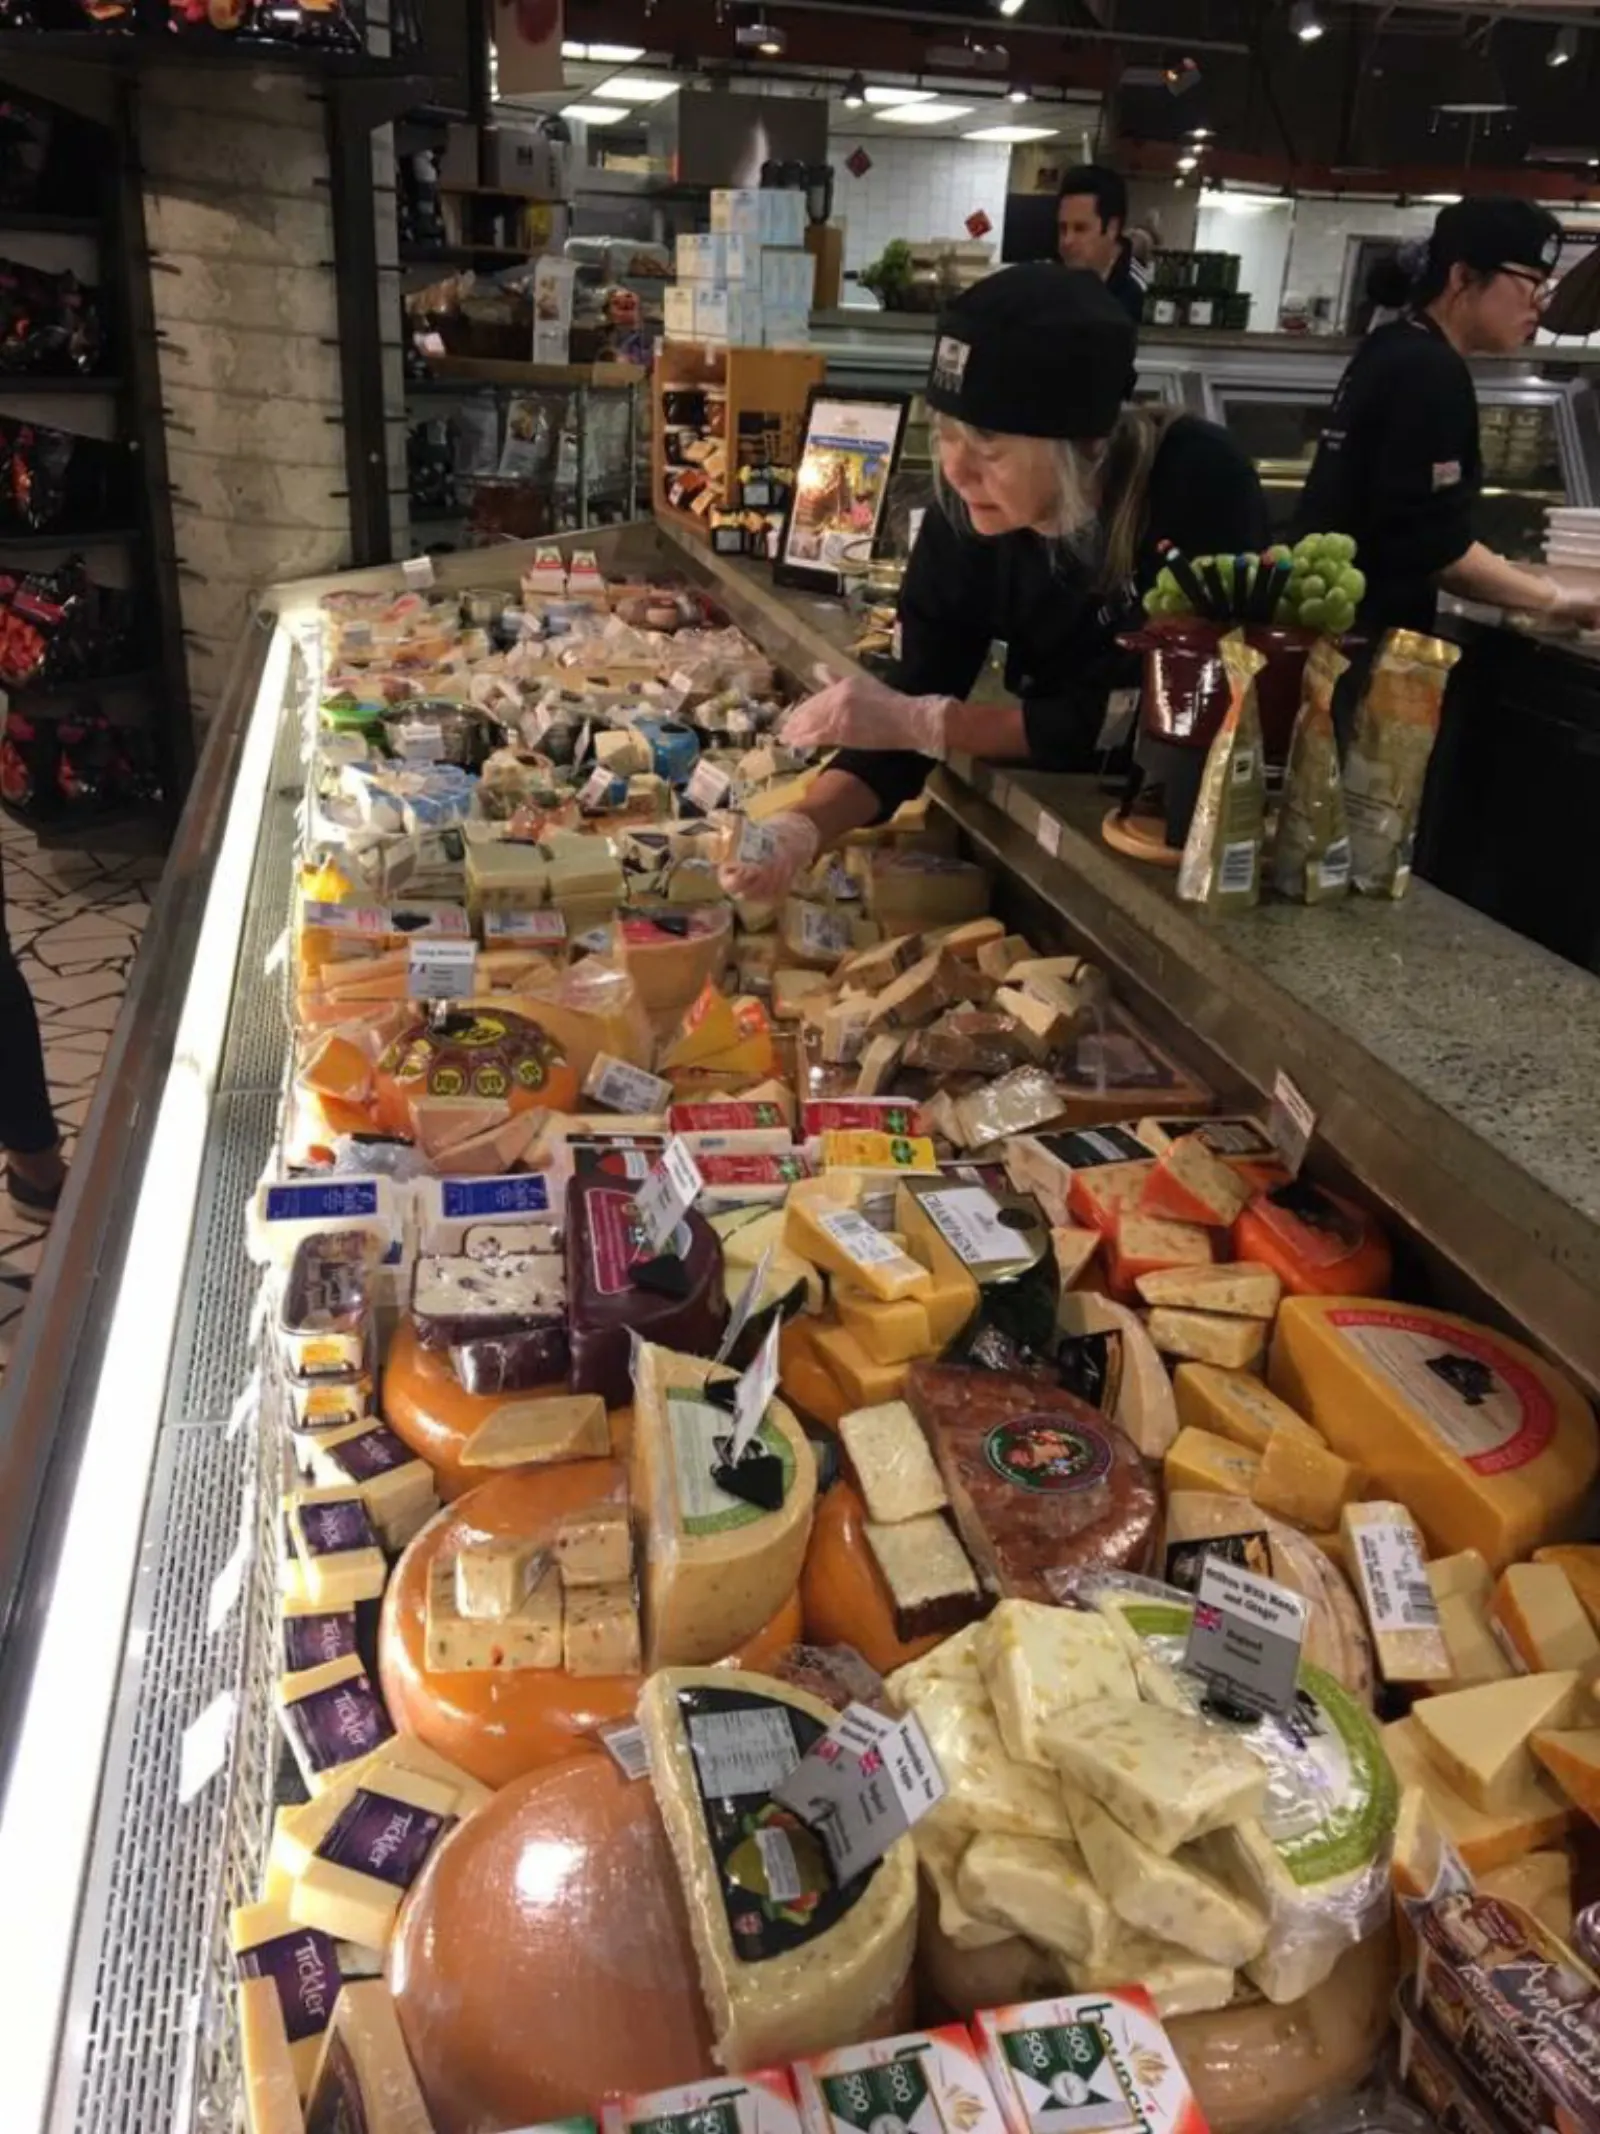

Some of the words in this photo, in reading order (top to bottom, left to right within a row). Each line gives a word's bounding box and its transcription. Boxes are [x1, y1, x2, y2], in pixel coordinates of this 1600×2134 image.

[333, 1688, 367, 1746] Tickler
[367, 1811, 413, 1870] Tickler
[293, 1935, 328, 2018] Tickler
